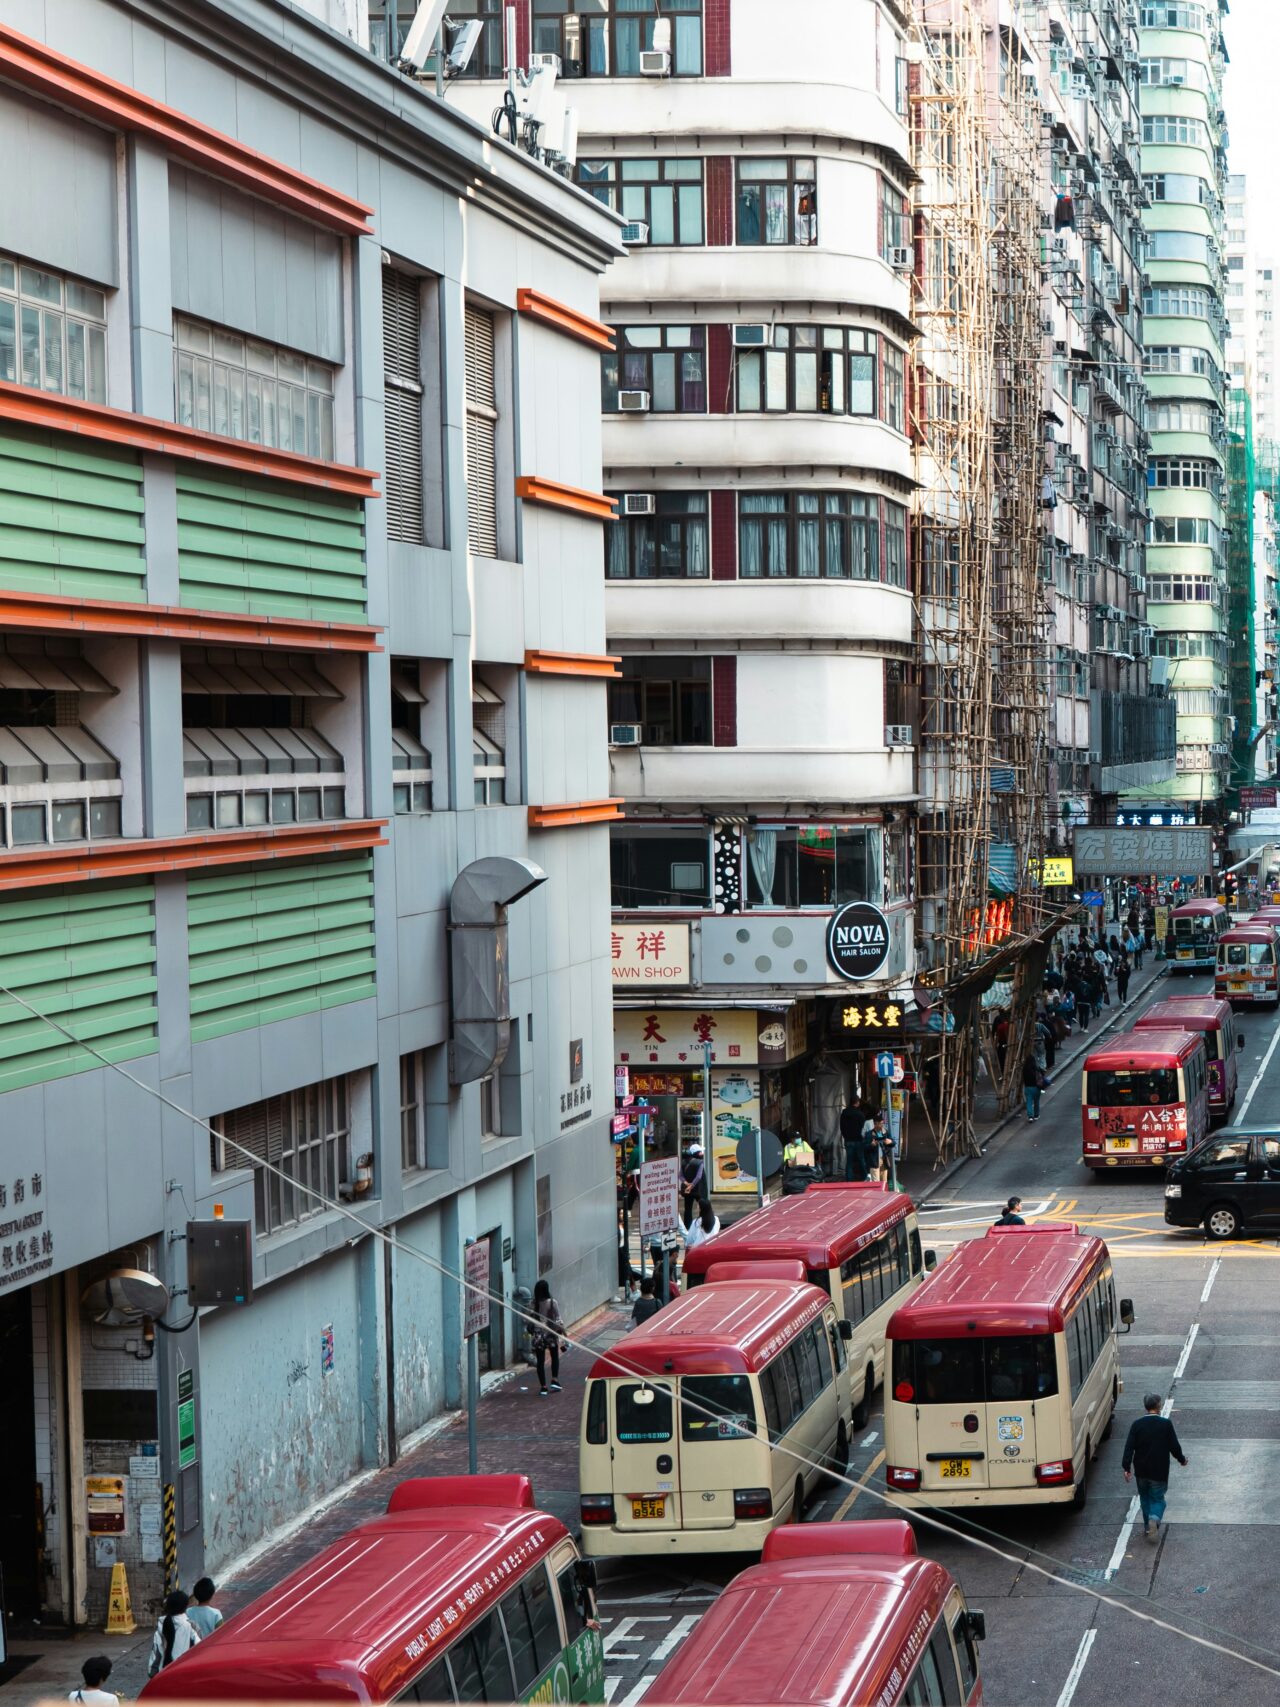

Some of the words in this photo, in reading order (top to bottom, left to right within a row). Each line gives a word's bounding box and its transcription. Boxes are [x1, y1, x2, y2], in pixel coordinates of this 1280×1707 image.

[837, 926, 885, 944] NOVA
[841, 949, 857, 957] HAIR
[859, 947, 881, 956] SALON
[644, 966, 682, 978] SHOP
[843, 1005, 901, 1028] 海天堂
[1142, 1108, 1186, 1122] 八合里
[652, 1162, 667, 1170] Vehicle
[642, 1186, 659, 1195] without
[660, 1184, 676, 1192] warning
[949, 1460, 962, 1468] GW
[943, 1468, 970, 1477] 2893
[634, 1507, 664, 1518] 8946
